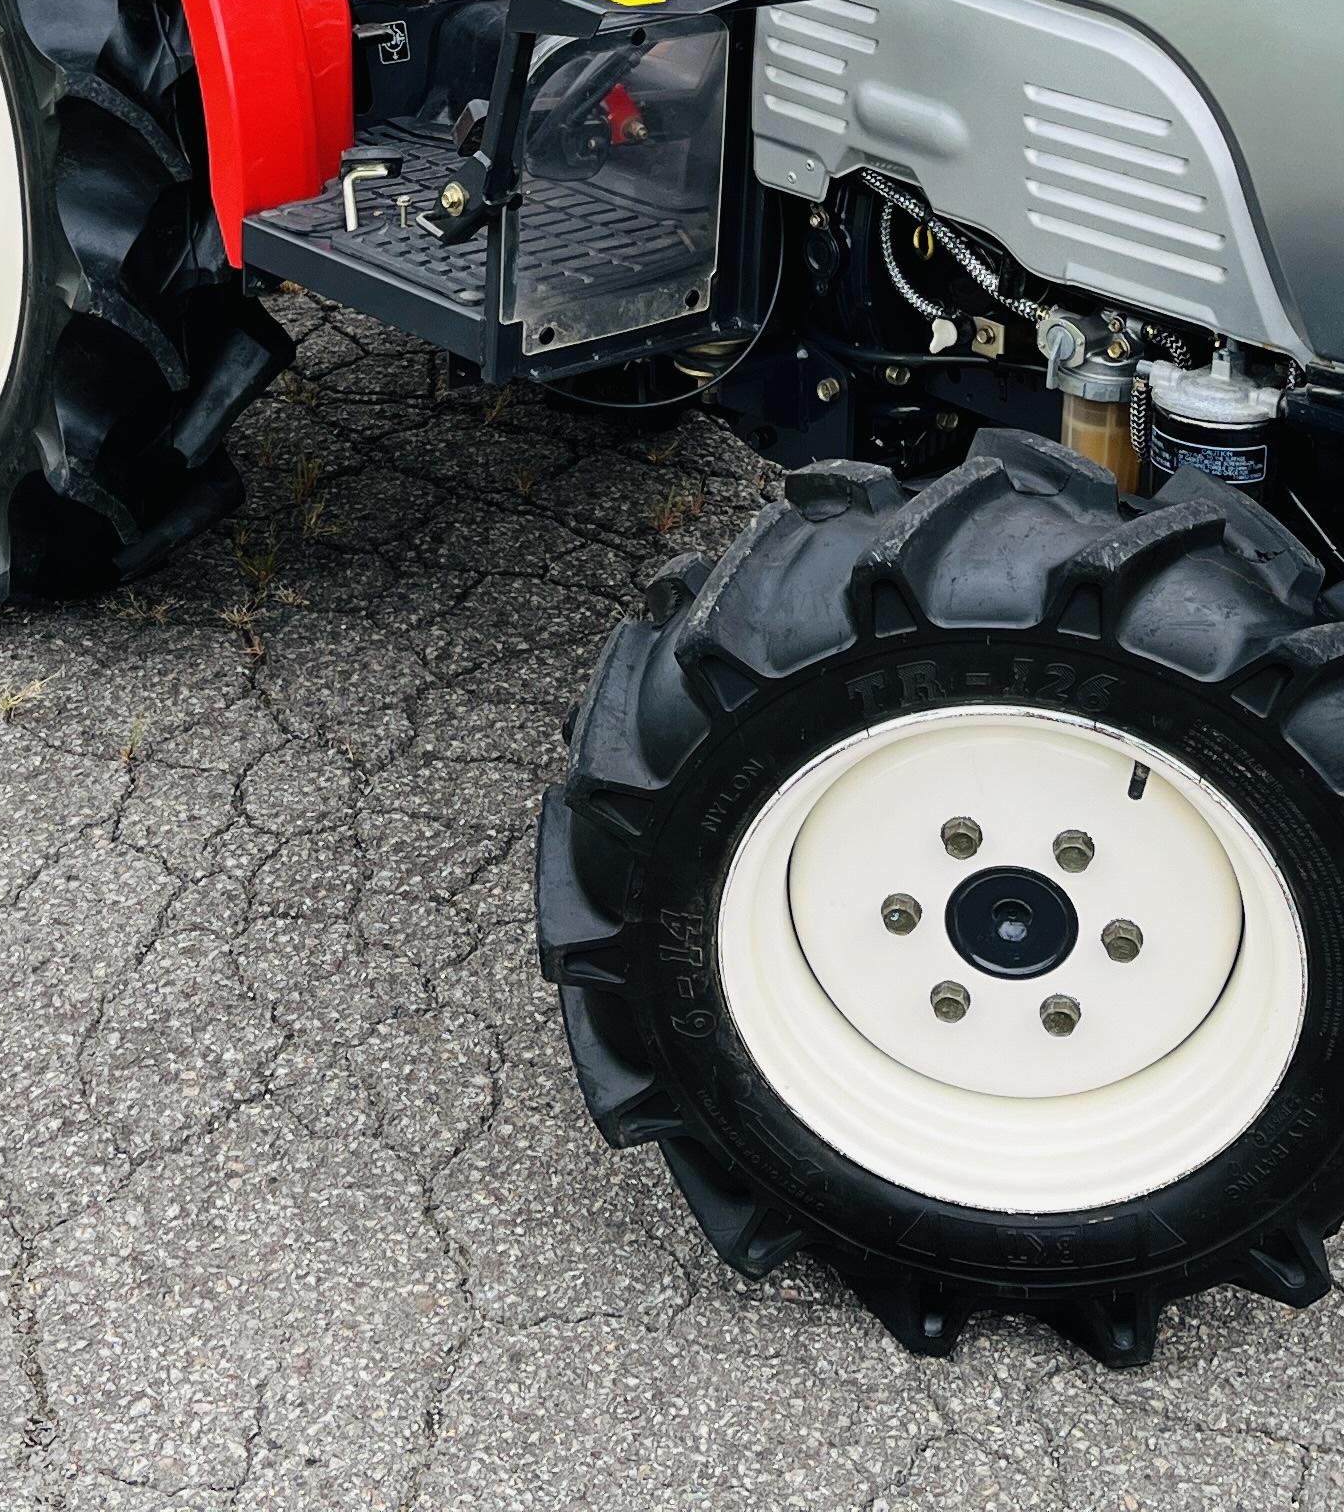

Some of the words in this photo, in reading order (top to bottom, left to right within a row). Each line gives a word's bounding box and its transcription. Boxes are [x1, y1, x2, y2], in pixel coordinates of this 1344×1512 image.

[844, 657, 1120, 719] TR-126
[700, 759, 764, 832] NYLON
[659, 908, 718, 1040] 6-14
